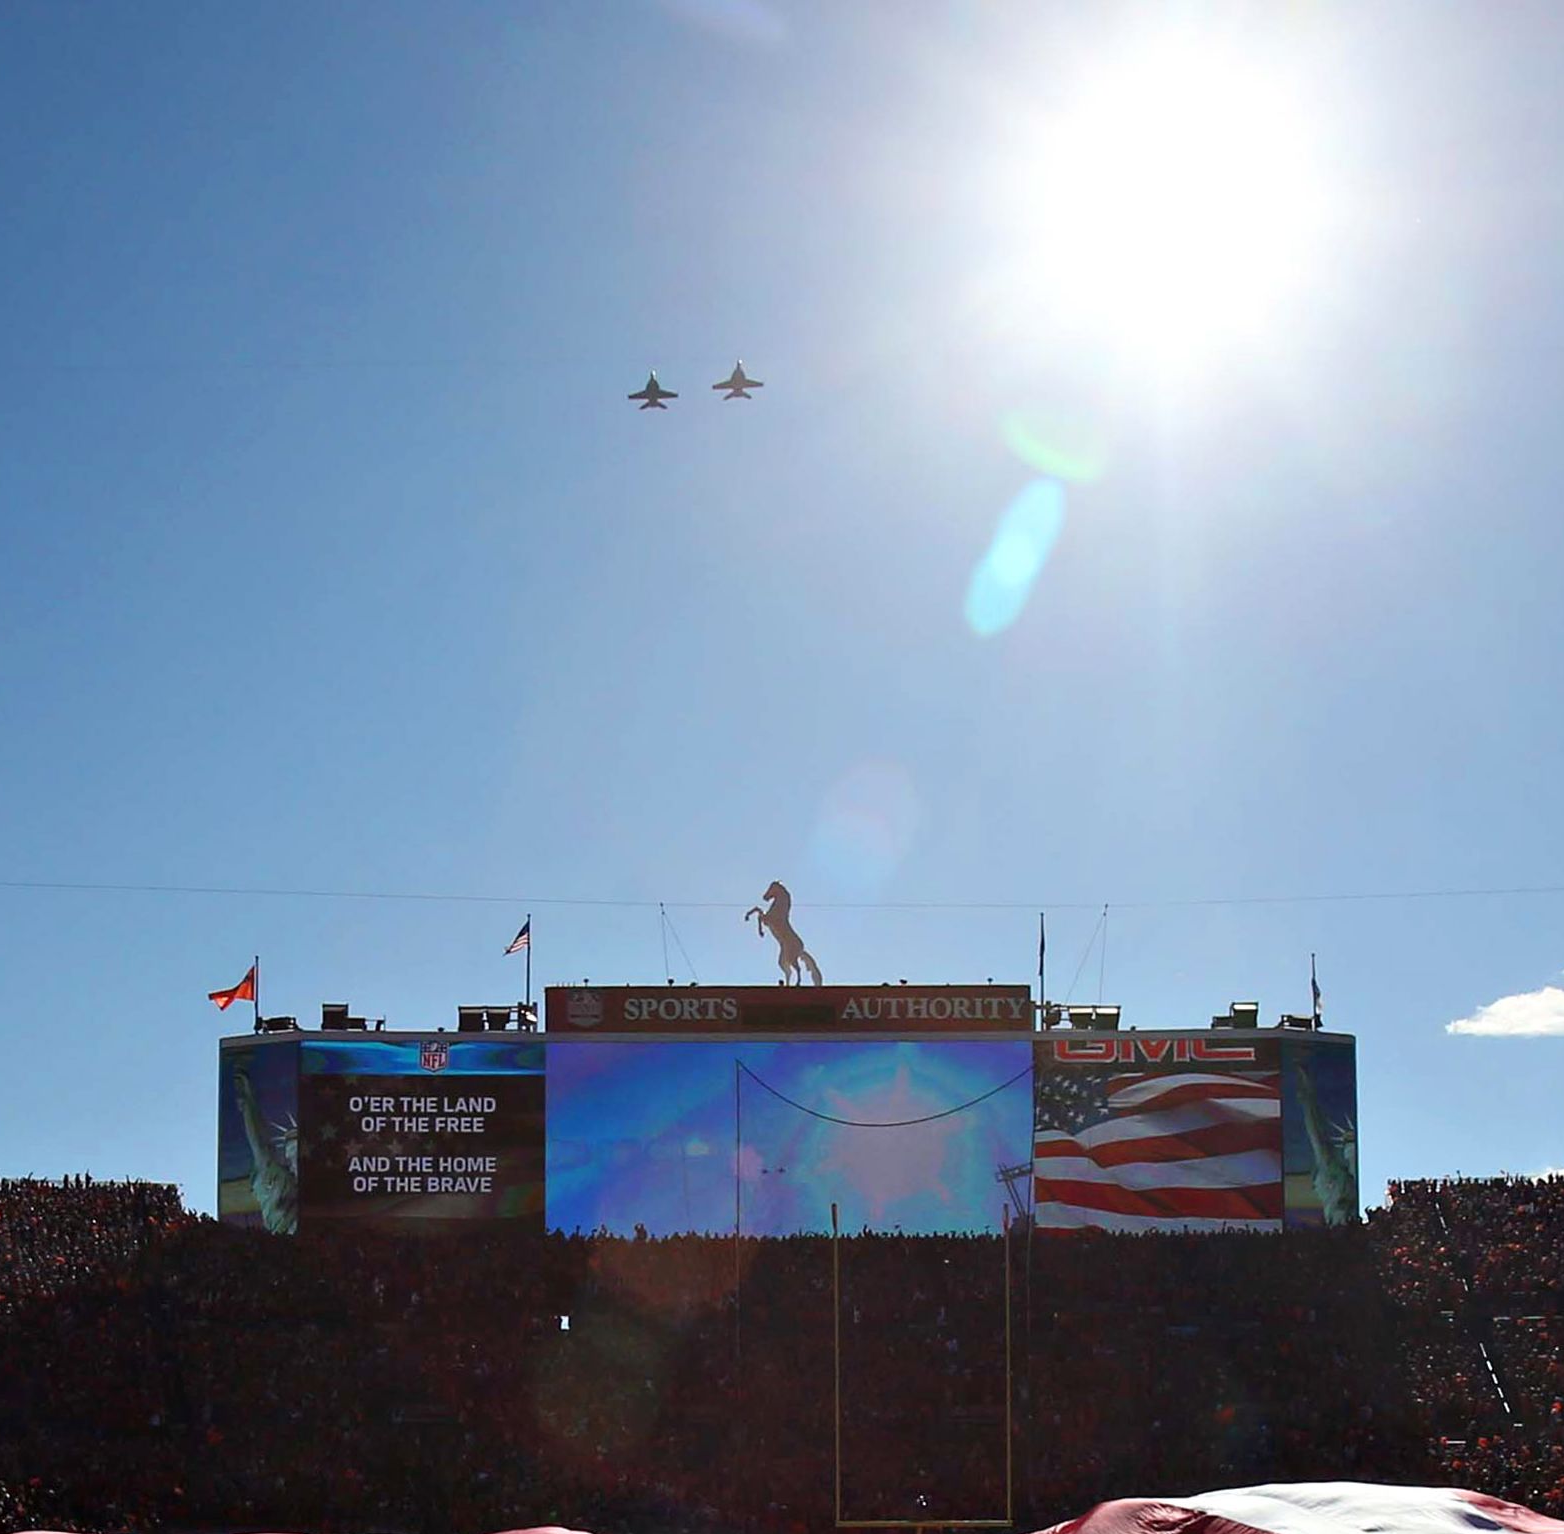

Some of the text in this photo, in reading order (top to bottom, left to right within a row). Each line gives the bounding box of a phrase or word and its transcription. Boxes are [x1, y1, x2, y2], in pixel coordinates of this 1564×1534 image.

[623, 997, 738, 1021] SPORTS
[840, 997, 1026, 1020] AUTHORITY
[1054, 1039, 1256, 1063] GMC
[422, 1053, 447, 1069] NFL
[349, 1096, 497, 1112] O'ER THE LAND
[361, 1117, 485, 1132] OF THE FREE
[348, 1157, 497, 1172] AND THE HOME
[353, 1177, 492, 1192] OF THE BRAVE
